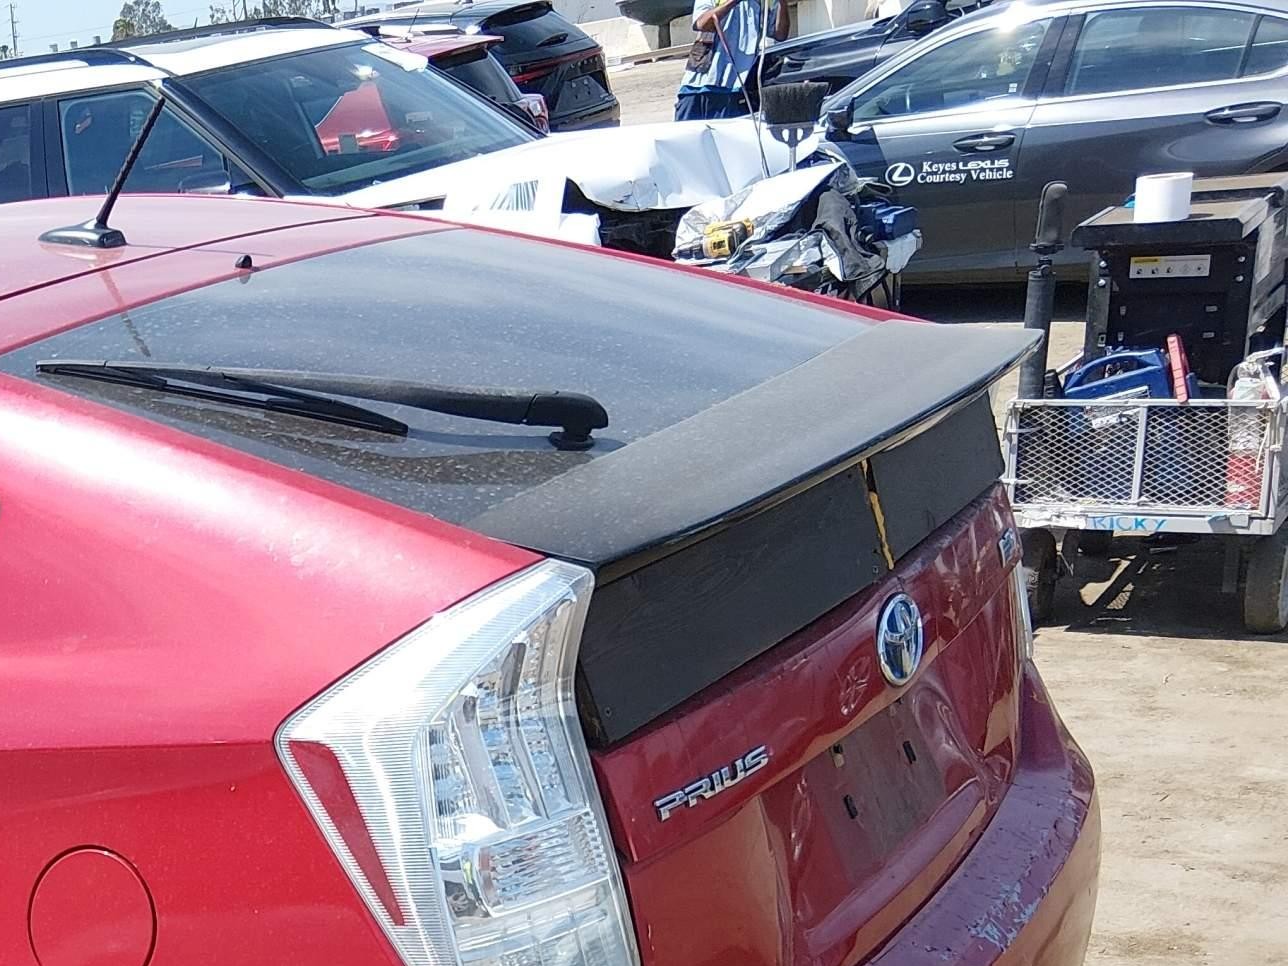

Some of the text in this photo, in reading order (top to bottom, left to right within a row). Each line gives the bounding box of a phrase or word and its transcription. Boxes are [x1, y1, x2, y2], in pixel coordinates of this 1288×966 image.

[922, 159, 1009, 174] Keyes LEXUS
[917, 169, 1013, 184] Courtesy Vehicle
[1092, 516, 1167, 532] RICKY
[653, 744, 769, 823] PRIUS
